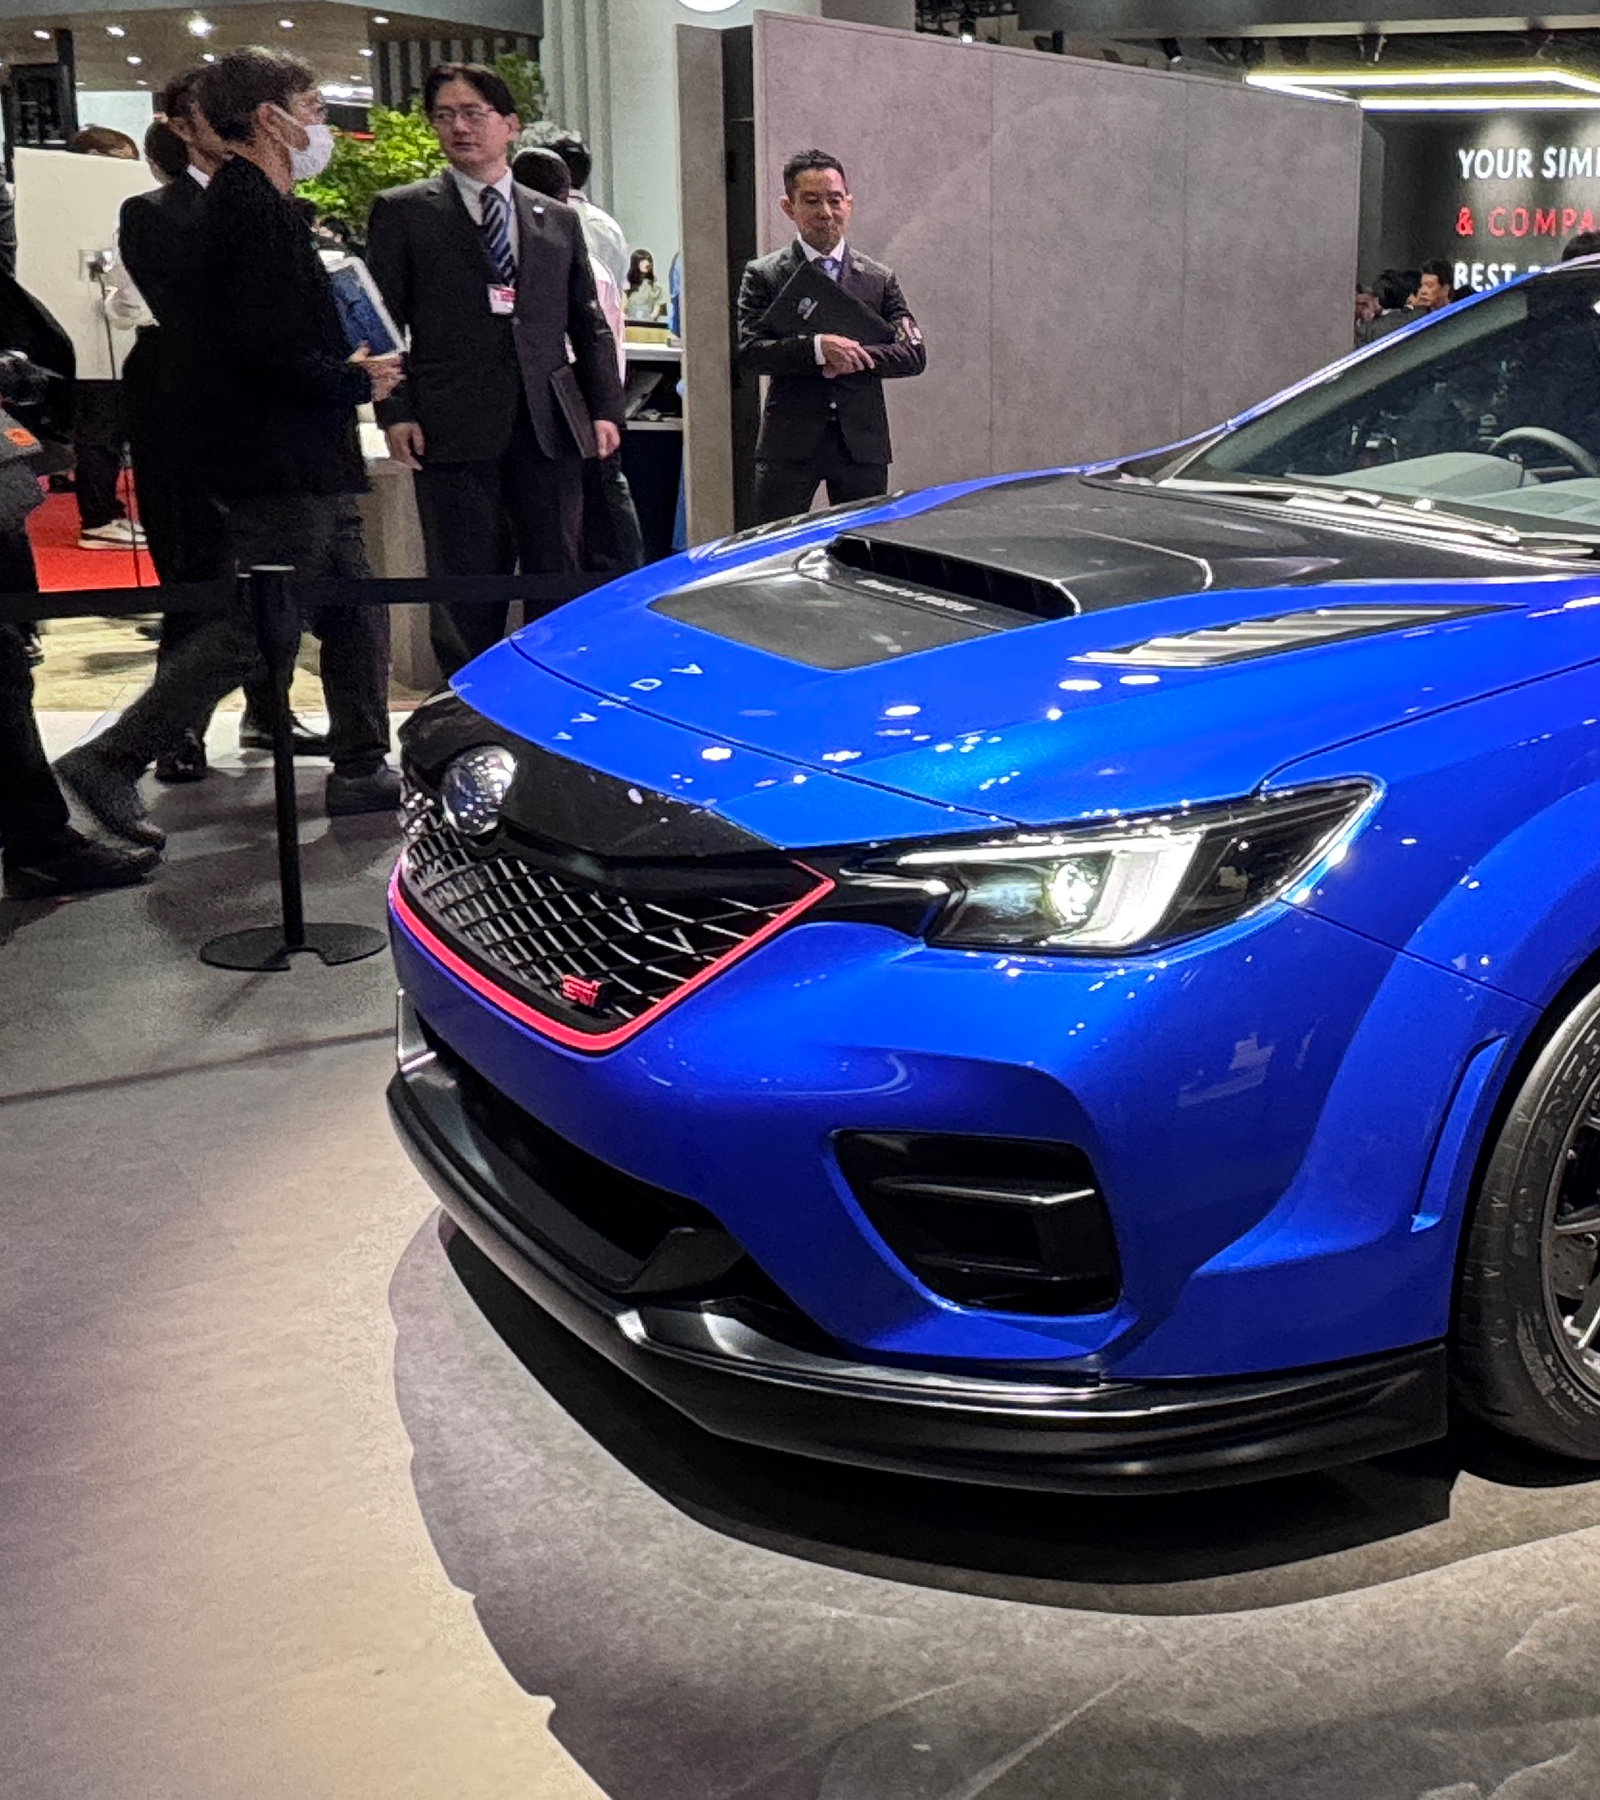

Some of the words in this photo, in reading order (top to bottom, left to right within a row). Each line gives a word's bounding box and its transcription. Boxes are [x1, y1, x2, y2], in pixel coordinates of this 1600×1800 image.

[1457, 147, 1534, 179] YOUR
[1455, 206, 1474, 237] &
[1454, 261, 1517, 292] BEST
